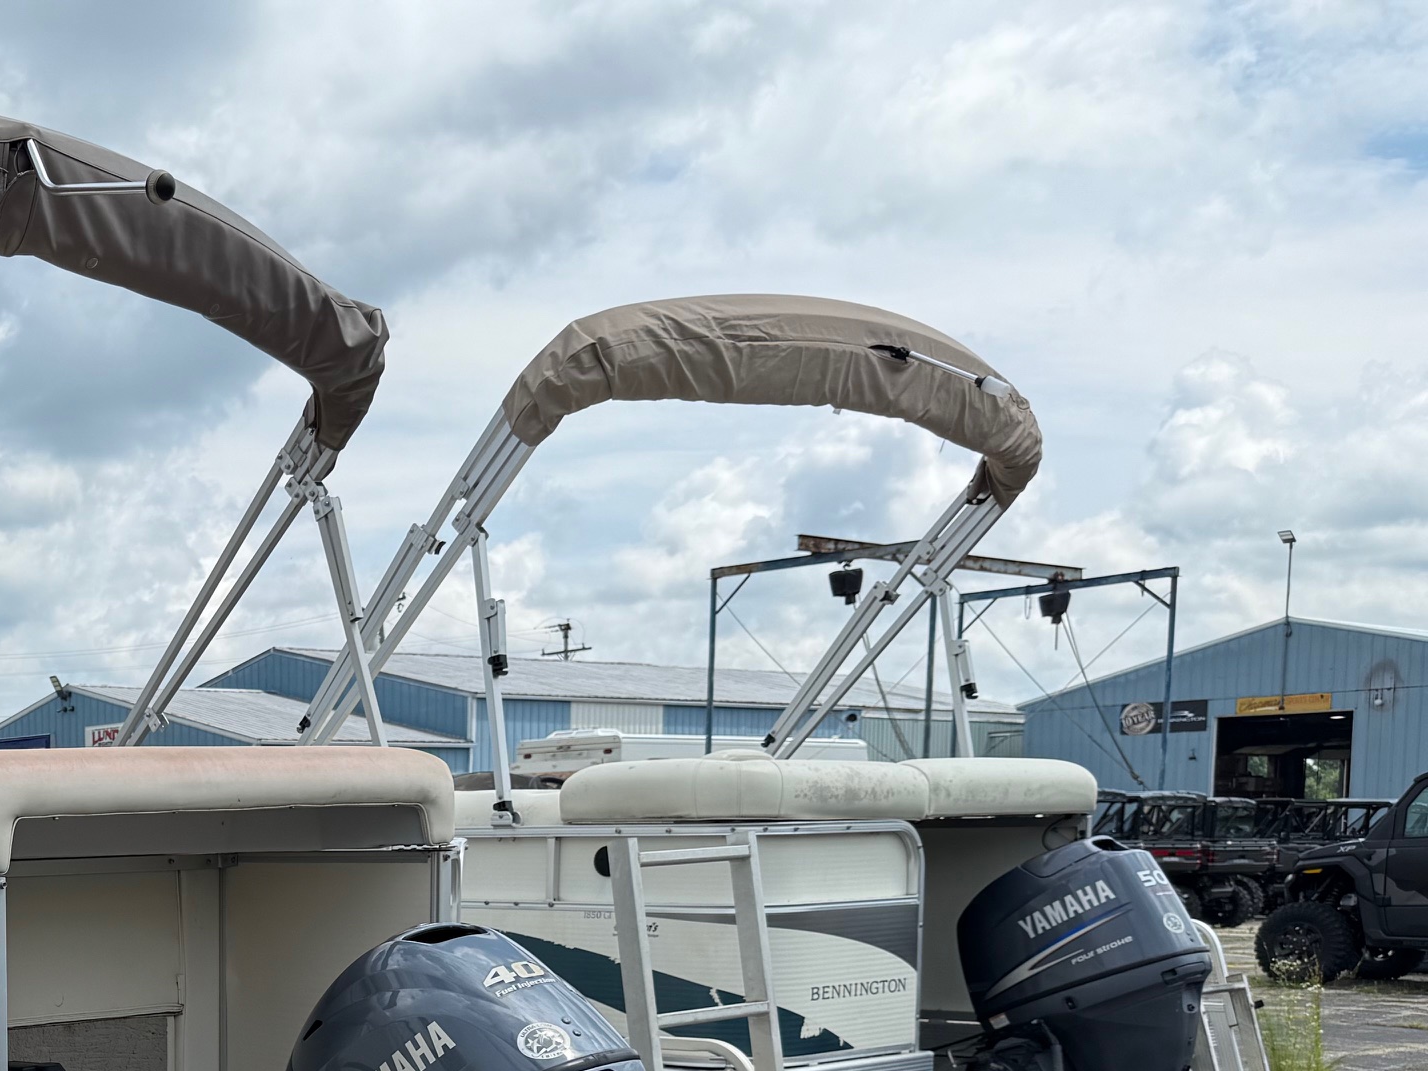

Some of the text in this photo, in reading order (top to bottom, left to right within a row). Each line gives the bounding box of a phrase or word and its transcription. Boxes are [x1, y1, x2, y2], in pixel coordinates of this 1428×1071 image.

[1136, 870, 1169, 887] 50
[1018, 879, 1116, 939] YAMAHA
[482, 961, 545, 989] 40
[495, 977, 556, 998] Fuel Injection
[810, 977, 908, 1001] BENNINGTON
